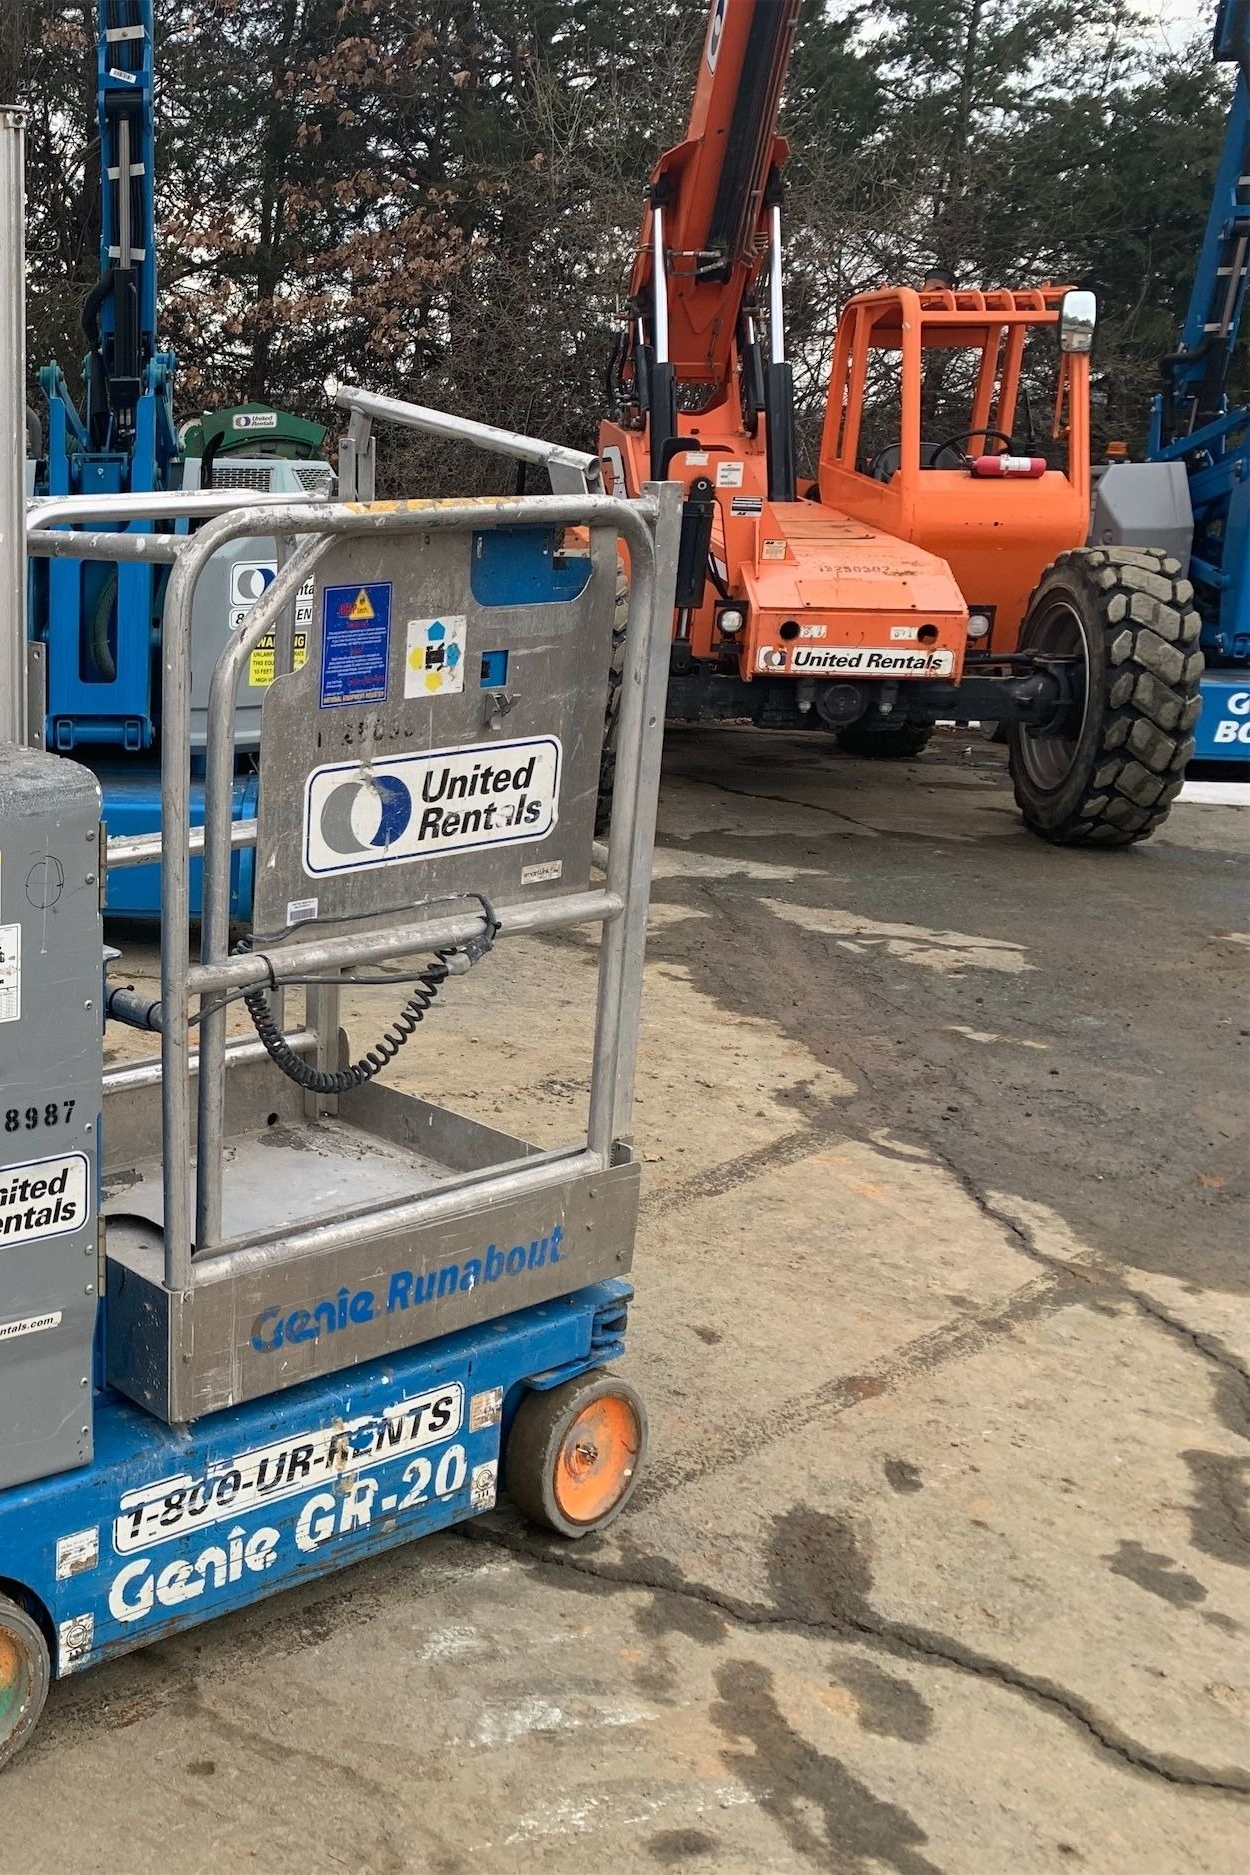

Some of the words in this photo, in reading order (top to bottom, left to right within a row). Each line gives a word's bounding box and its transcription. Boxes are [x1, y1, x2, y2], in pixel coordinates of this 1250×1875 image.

[794, 651, 862, 668] United
[866, 653, 943, 670] Rentals
[422, 755, 536, 803] United
[250, 1288, 377, 1354] Genie
[385, 1224, 566, 1316] Runabout
[108, 1523, 281, 1623] Genie
[295, 1443, 468, 1553] GR-20
